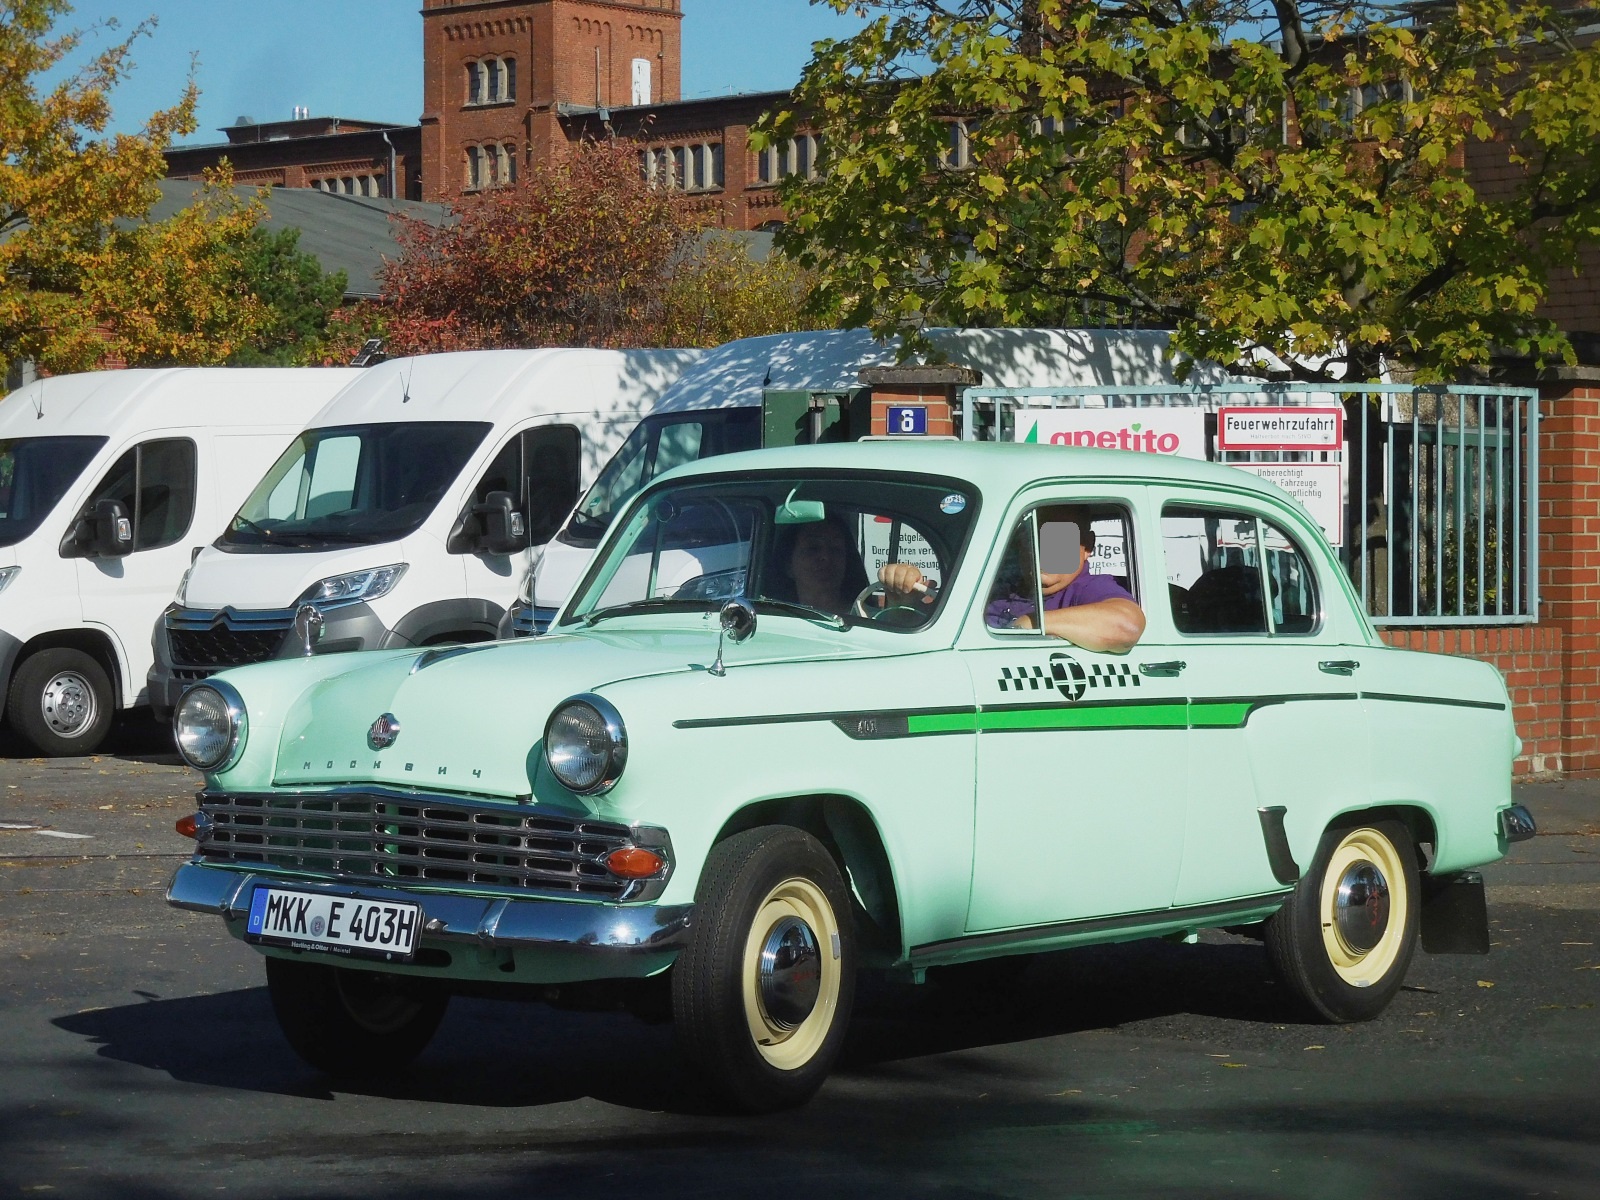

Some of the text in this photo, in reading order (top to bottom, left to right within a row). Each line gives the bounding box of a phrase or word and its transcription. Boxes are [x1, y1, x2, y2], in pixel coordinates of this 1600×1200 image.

[901, 409, 914, 432] 6
[1227, 417, 1334, 431] Feuerwehrzufahrt
[1050, 423, 1180, 453] apetito
[1257, 468, 1303, 479] Unberechtigt
[1280, 479, 1318, 489] Fahrzeuge
[253, 915, 260, 926] D
[264, 894, 415, 947] MKK E 403H
